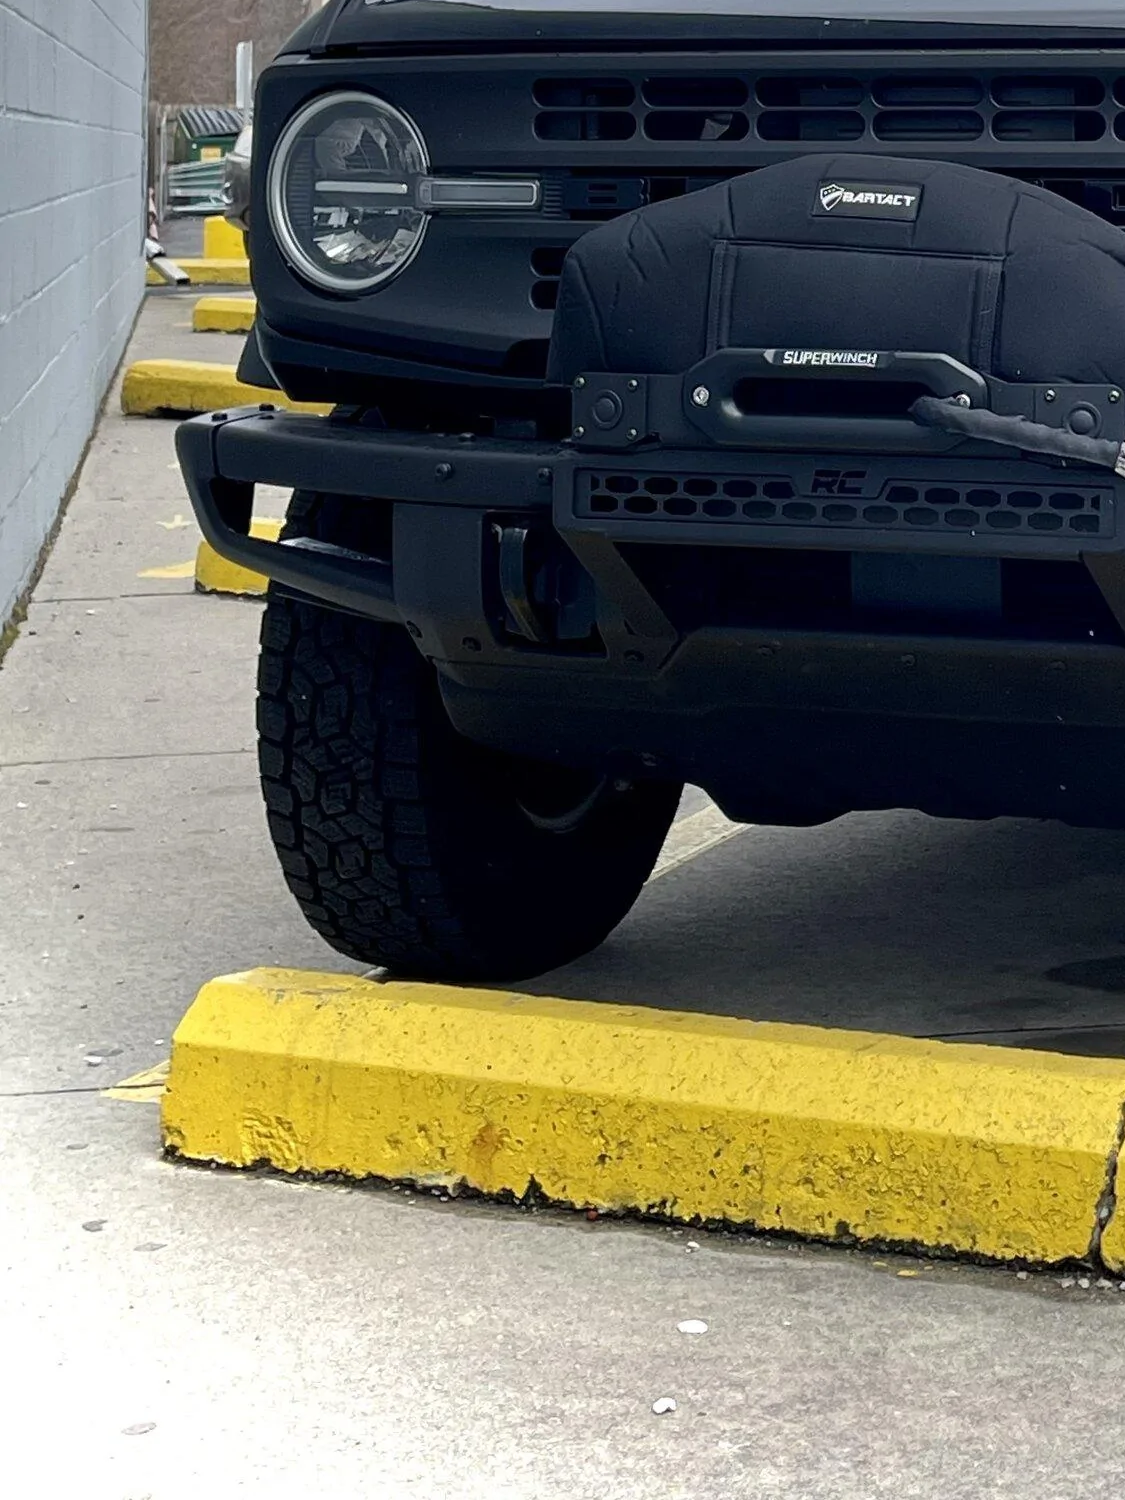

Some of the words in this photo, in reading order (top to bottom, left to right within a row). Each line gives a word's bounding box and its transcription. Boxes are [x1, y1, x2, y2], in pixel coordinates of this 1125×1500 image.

[842, 191, 915, 206] BARTACT
[783, 350, 878, 368] SUPERWINCH
[811, 469, 867, 494] RC
